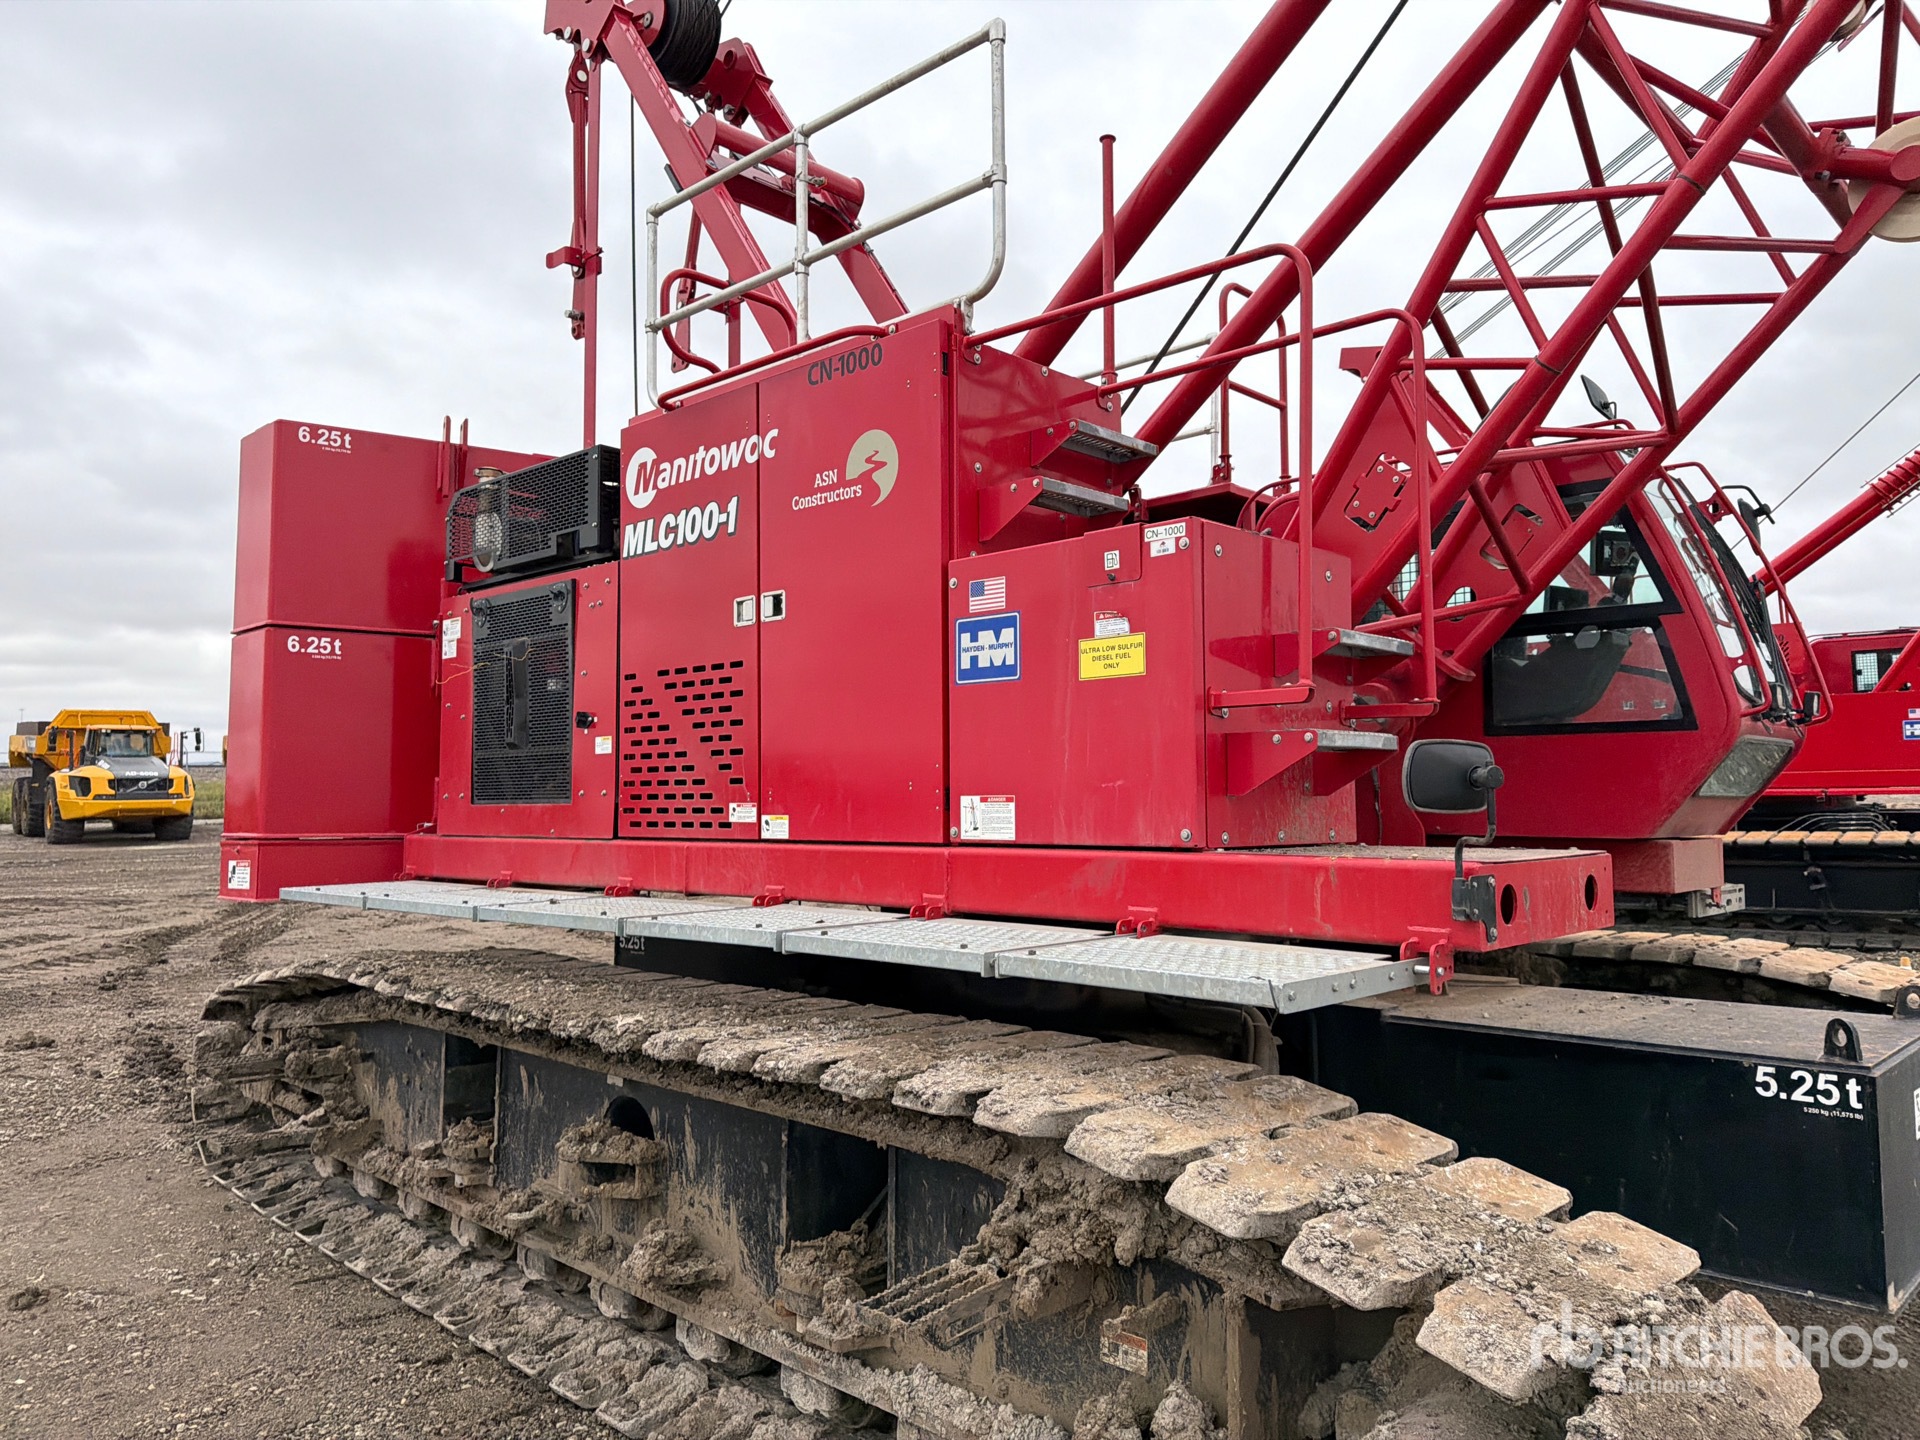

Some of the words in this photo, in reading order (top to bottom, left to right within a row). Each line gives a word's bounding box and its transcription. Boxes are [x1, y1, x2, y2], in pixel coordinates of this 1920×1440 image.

[808, 343, 883, 386] CN-1000
[629, 428, 779, 503] Manitowoc
[814, 469, 838, 488] ASN
[792, 484, 862, 510] Constructors
[622, 495, 740, 560] MLC100-1
[1145, 525, 1184, 540] CN-1000
[960, 627, 1015, 670] HM
[1080, 647, 1101, 655] ULTRA
[1102, 645, 1116, 653] LOW
[1118, 641, 1143, 651] SULFUR
[1115, 652, 1132, 660] FUEL
[1103, 662, 1120, 670] ONLY
[1820, 1109, 1829, 1117] kg
